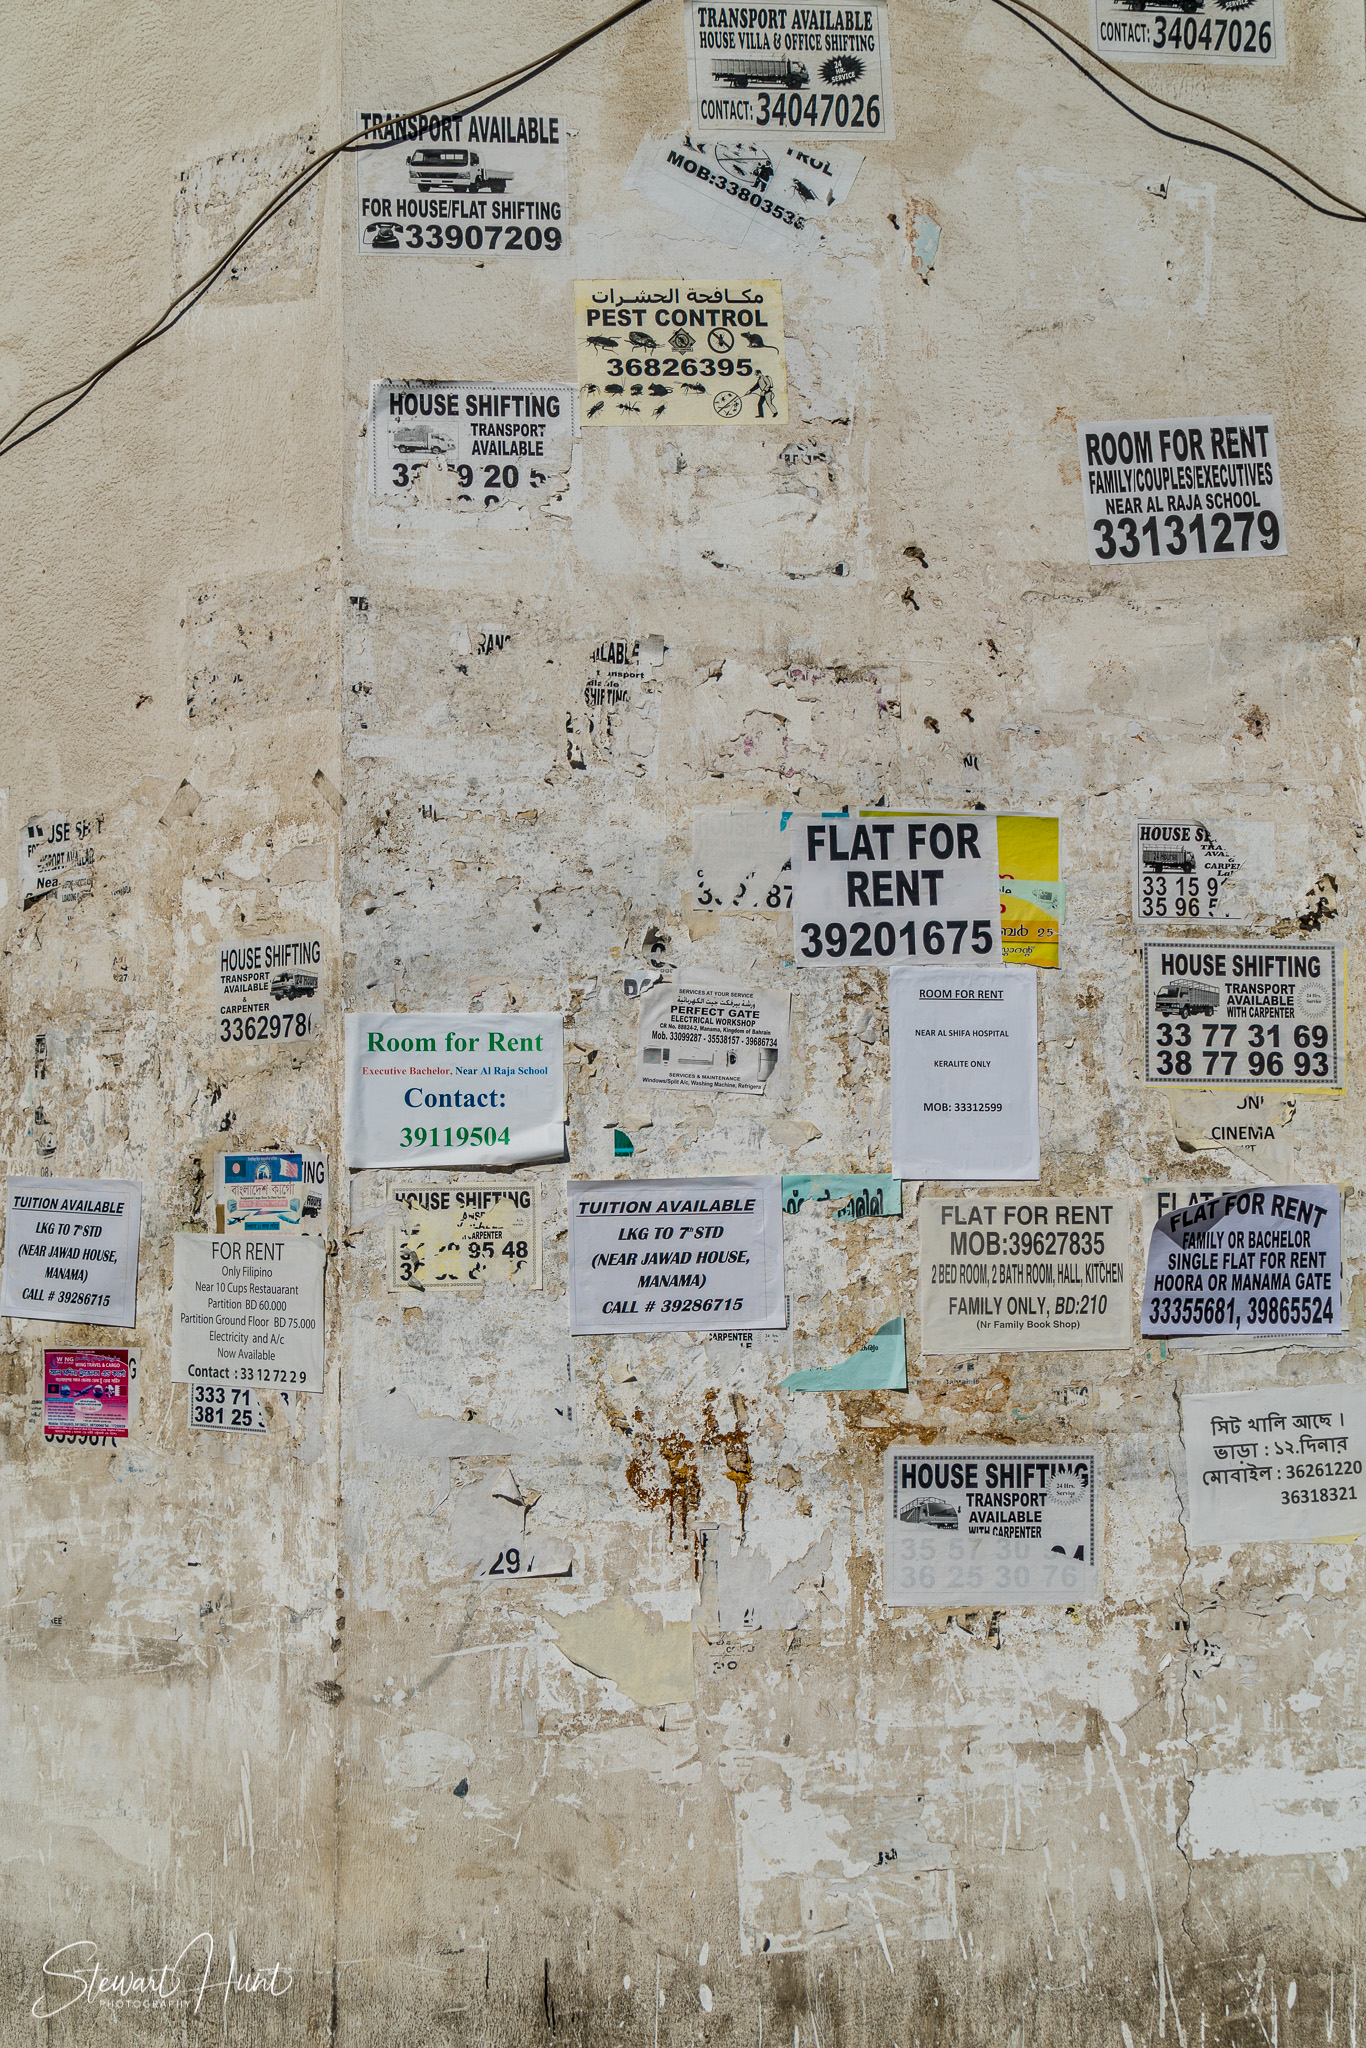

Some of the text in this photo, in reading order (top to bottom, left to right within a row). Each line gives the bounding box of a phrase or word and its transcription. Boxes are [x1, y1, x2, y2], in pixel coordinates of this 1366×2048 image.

[698, 7, 873, 31] TRANSPORT AVAILABLE
[699, 31, 875, 52] HOUSE VILLA & OFFICE SHIFTING
[701, 92, 881, 128] CONTACT: 34047026
[361, 112, 560, 144] TRANSPORT AVAILABLE
[362, 198, 562, 220] FOR HOUSE/FLAT SHIFTING
[405, 224, 563, 251] 33907209
[592, 287, 764, 307] مكافحة الحشرات
[587, 308, 768, 327] PEST CONTROL
[606, 358, 753, 377] 36826395
[1085, 425, 1269, 466] ROOM FOR RENT
[1105, 491, 1260, 515] NEAR AL RAJA SCHOOL
[1093, 510, 1280, 560] 33131279
[806, 823, 981, 861] FLAT FOR
[847, 870, 944, 907] RENT
[801, 920, 994, 957] 39201675
[221, 941, 320, 972] HOUSE SHIFTING
[1161, 953, 1321, 978] HOUSE SHIFTING
[919, 989, 1004, 999] ROOM FOR RENT
[670, 1005, 760, 1018] PERFECT GATE
[671, 1015, 756, 1027] ELECTRICAL WORKSHOP
[366, 1031, 544, 1052] Room for Rent
[652, 1031, 778, 1047] Mob. 33099287 35538157 39686734
[915, 1029, 936, 1037] NEAR
[362, 1067, 548, 1077] Executive Bachelor, Near Al Raja School
[933, 1060, 992, 1068] KERALITE ONLY
[404, 1087, 506, 1108] Contact:
[923, 1103, 1003, 1112] MOB: 33312599
[399, 1126, 511, 1147] 39119504
[1211, 1126, 1275, 1140] CINEMA
[231, 1181, 295, 1197] বাংলাদেশ কার্গো
[14, 1196, 125, 1214] TUITION AVAILABLE
[941, 1205, 1113, 1225] FLAT FOR RENT
[35, 1222, 102, 1238] LKG TO STD
[1183, 1230, 1311, 1249] FAMILY OR BACHELOR
[212, 1241, 285, 1261] FOR RENT
[950, 1231, 1105, 1256] MOB:39627835
[18, 1244, 117, 1264] (NEAR JAWAD HOUSE,
[45, 1267, 89, 1283] MANAMA)
[221, 1266, 273, 1279] Only Filipino
[931, 1262, 1124, 1287] 2 BED ROOM, 2 BATH ROOM, HALL, KITCHEN
[1154, 1272, 1331, 1292] HOORA OR MANAMA GATE
[22, 1288, 111, 1307] CALL # 39286715
[195, 1281, 299, 1295] Near 10 Cups Restauarant
[208, 1298, 287, 1311] Partition BD 60.000
[949, 1294, 1107, 1318] FAMILY ONLY, BD:210
[1149, 1296, 1334, 1330] 33355681, 39865524
[180, 1313, 316, 1329] Partition Ground Floor BD 75.000
[976, 1320, 1080, 1331] (Nr Family Book Shop)
[209, 1331, 285, 1345] Electricity and A/c
[217, 1348, 275, 1361] Now Available
[1210, 1412, 1332, 1436] সিট খালি আছে
[1213, 1442, 1258, 1465] ভাড়া
[901, 1463, 978, 1489] HOUSE
[1202, 1460, 1362, 1486] মোবাইল 36261220
[1280, 1486, 1358, 1505] 36318321
[901, 1565, 1077, 1589] 36 25 30 76
